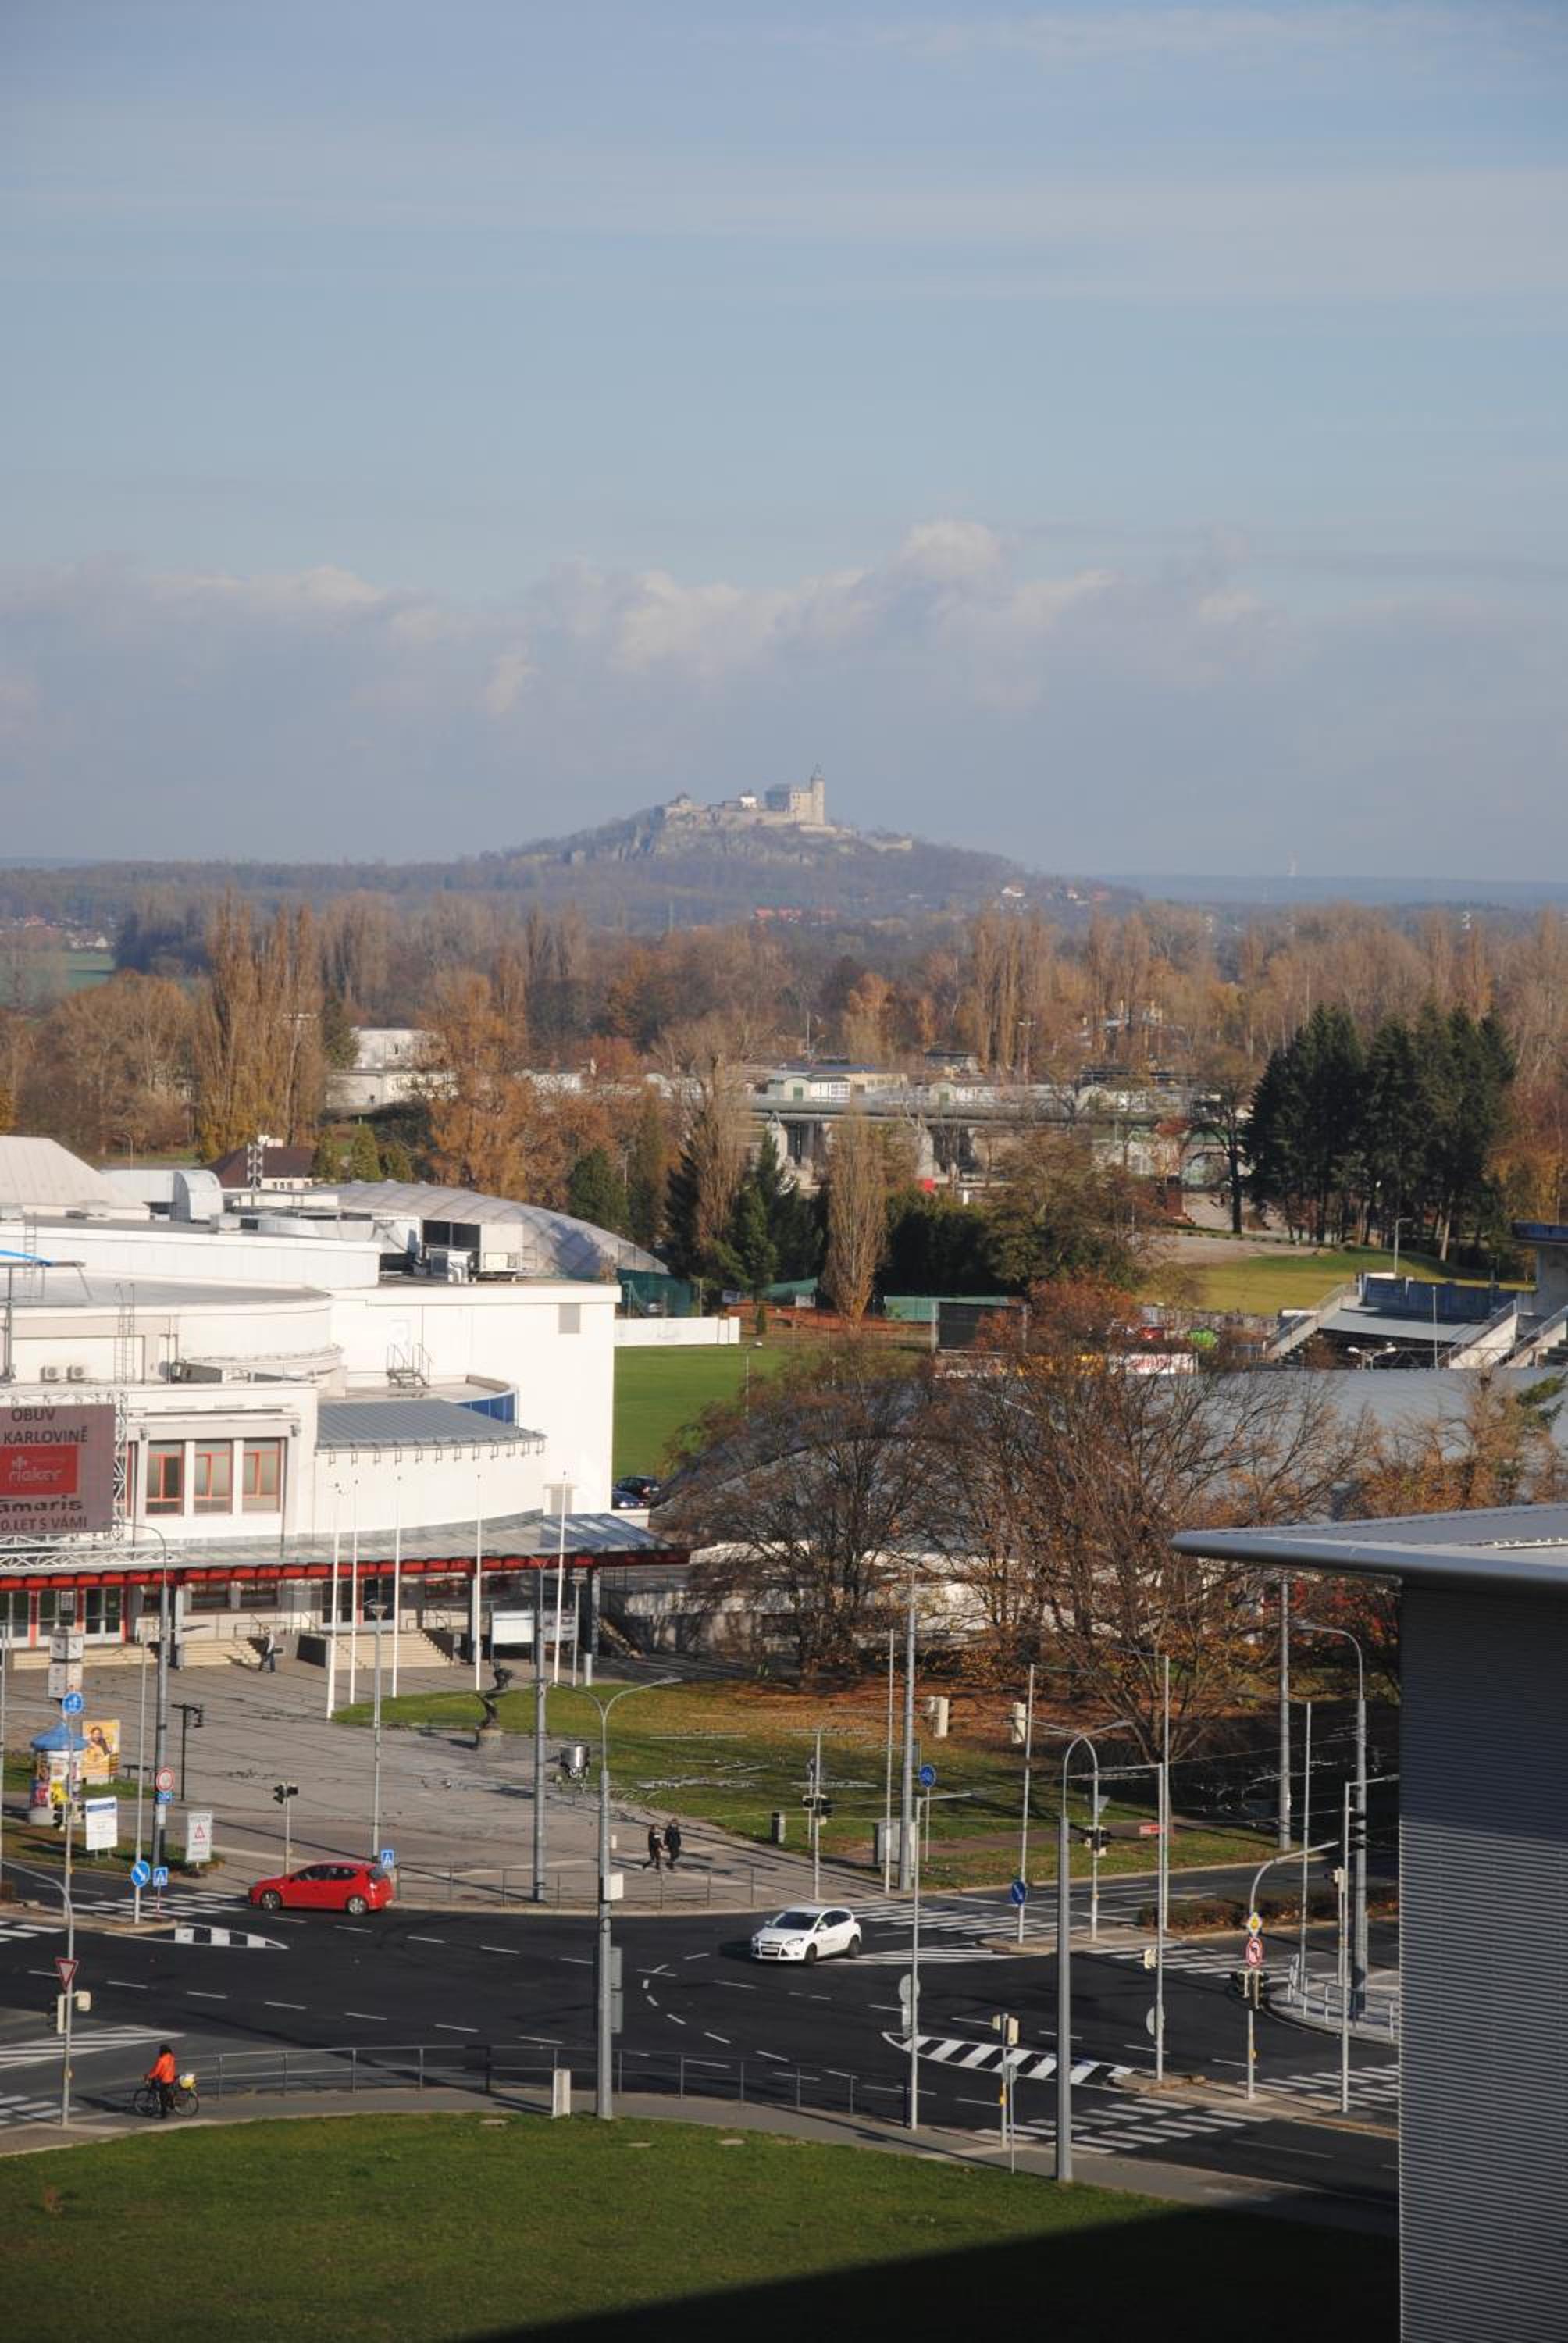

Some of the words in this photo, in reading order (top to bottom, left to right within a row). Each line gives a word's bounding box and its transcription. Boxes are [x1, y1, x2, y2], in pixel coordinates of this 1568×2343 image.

[12, 1407, 55, 1421] OBUV
[0, 1495, 84, 1513] amaris
[40, 1517, 47, 1530] S
[52, 1515, 87, 1529] VÁMI
